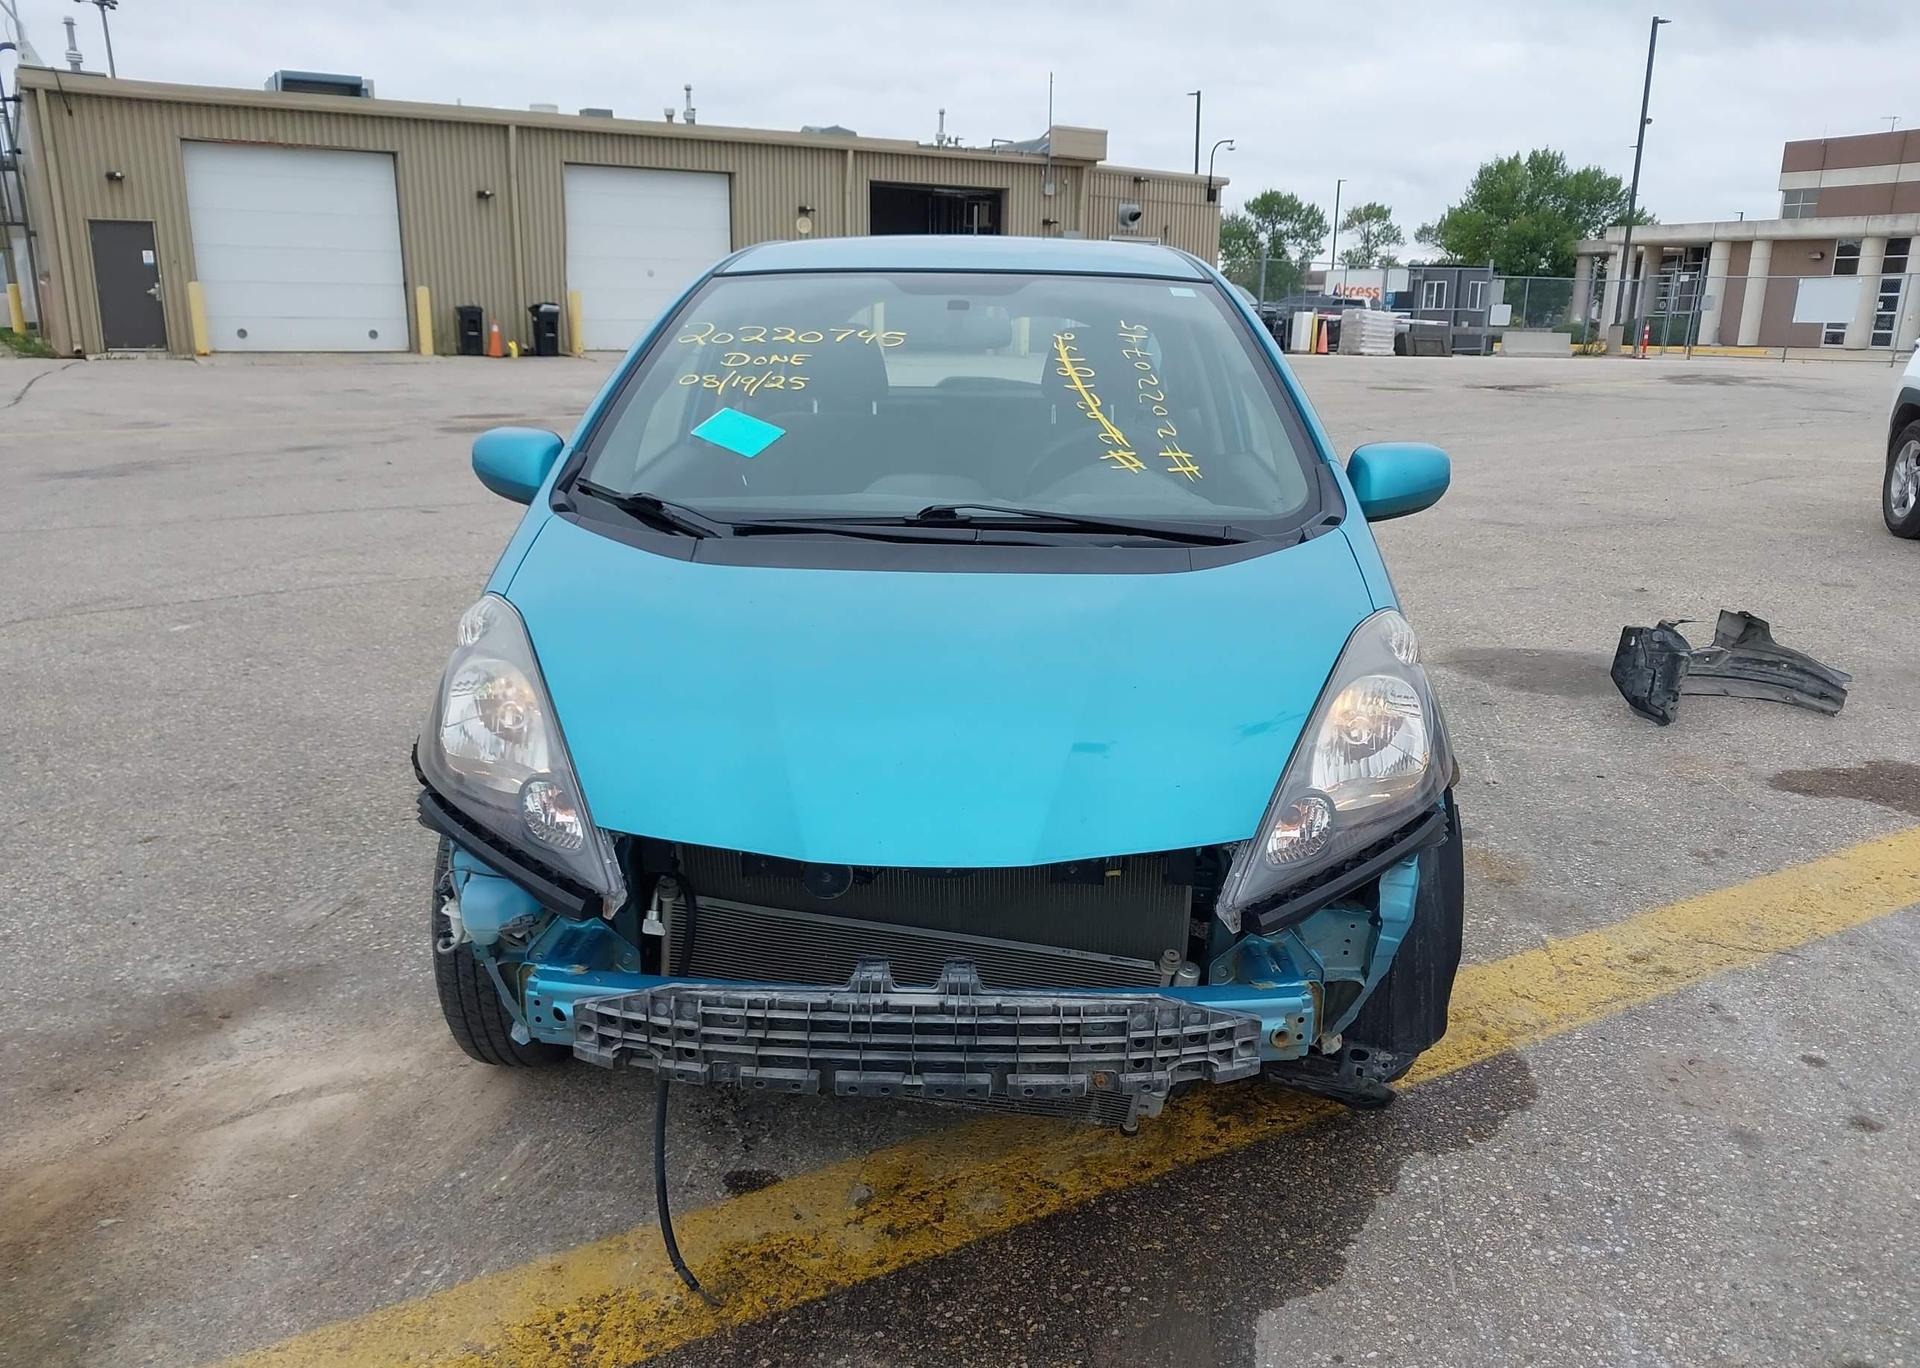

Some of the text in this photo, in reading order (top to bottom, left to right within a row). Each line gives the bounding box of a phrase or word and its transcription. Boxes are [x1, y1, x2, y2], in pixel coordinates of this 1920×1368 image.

[678, 322, 907, 347] 20220745
[720, 352, 812, 367] DONE
[678, 370, 810, 396] 08/19/25
